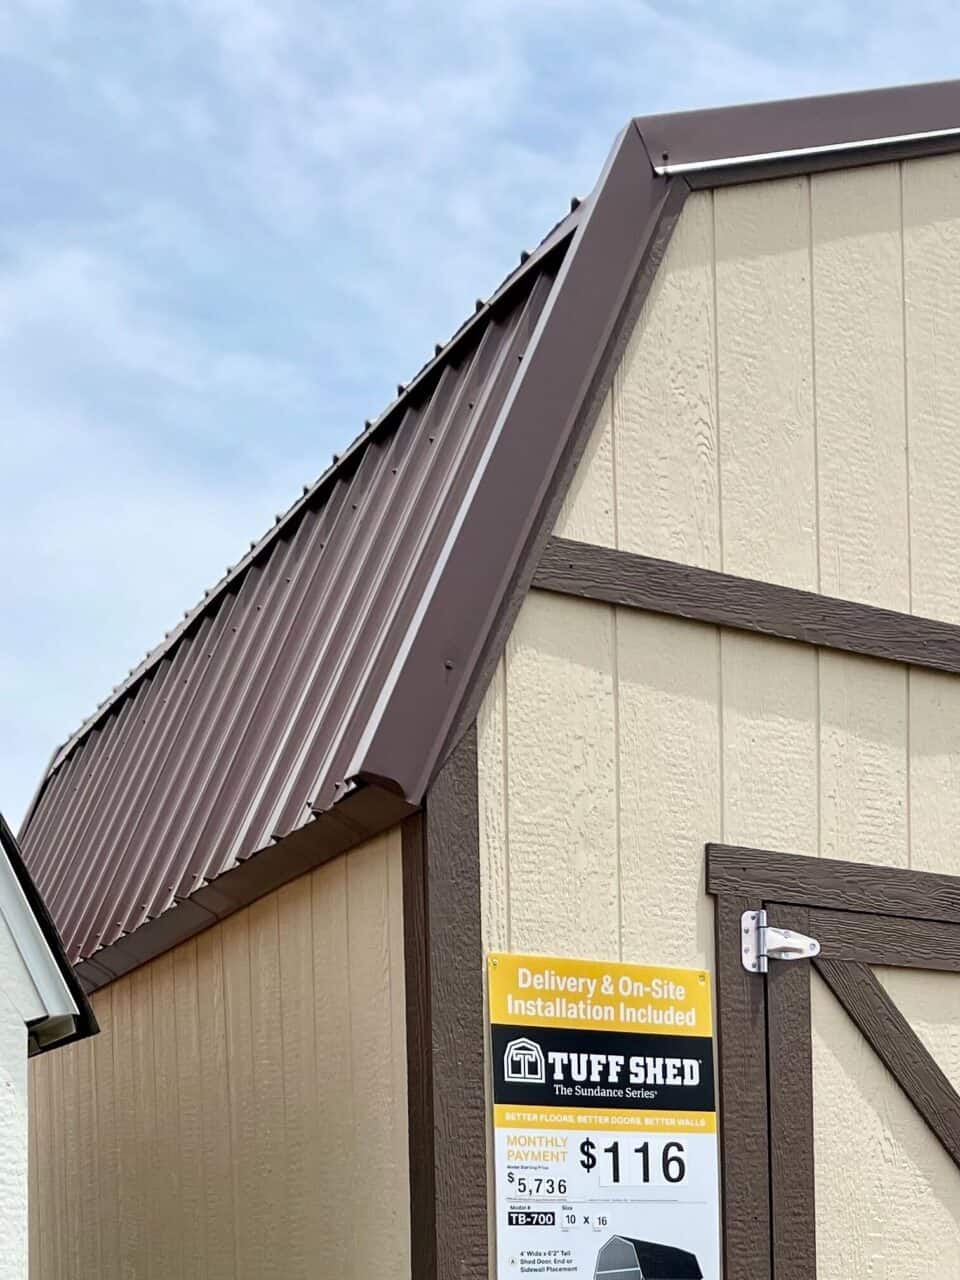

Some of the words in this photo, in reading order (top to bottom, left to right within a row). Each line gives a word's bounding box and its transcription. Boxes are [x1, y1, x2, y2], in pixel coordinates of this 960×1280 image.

[517, 967, 597, 997] Delivery
[601, 973, 614, 996] &
[618, 976, 686, 1001] On-Site
[506, 993, 615, 1021] Installation
[619, 1002, 697, 1027] Included
[547, 1051, 625, 1084] TUFF
[628, 1056, 701, 1087] SHED
[553, 1083, 574, 1097] The
[574, 1084, 624, 1099] Sundance
[504, 1111, 538, 1122] BETTER
[577, 1114, 610, 1125] BETTER
[506, 1135, 569, 1148] MONTHLY
[506, 1149, 569, 1163] PAYMENT
[579, 1136, 687, 1184] $116
[507, 1171, 568, 1196] $5,736
[509, 1213, 554, 1226] TB-700
[565, 1214, 577, 1225] 10
[597, 1215, 608, 1227] 16
